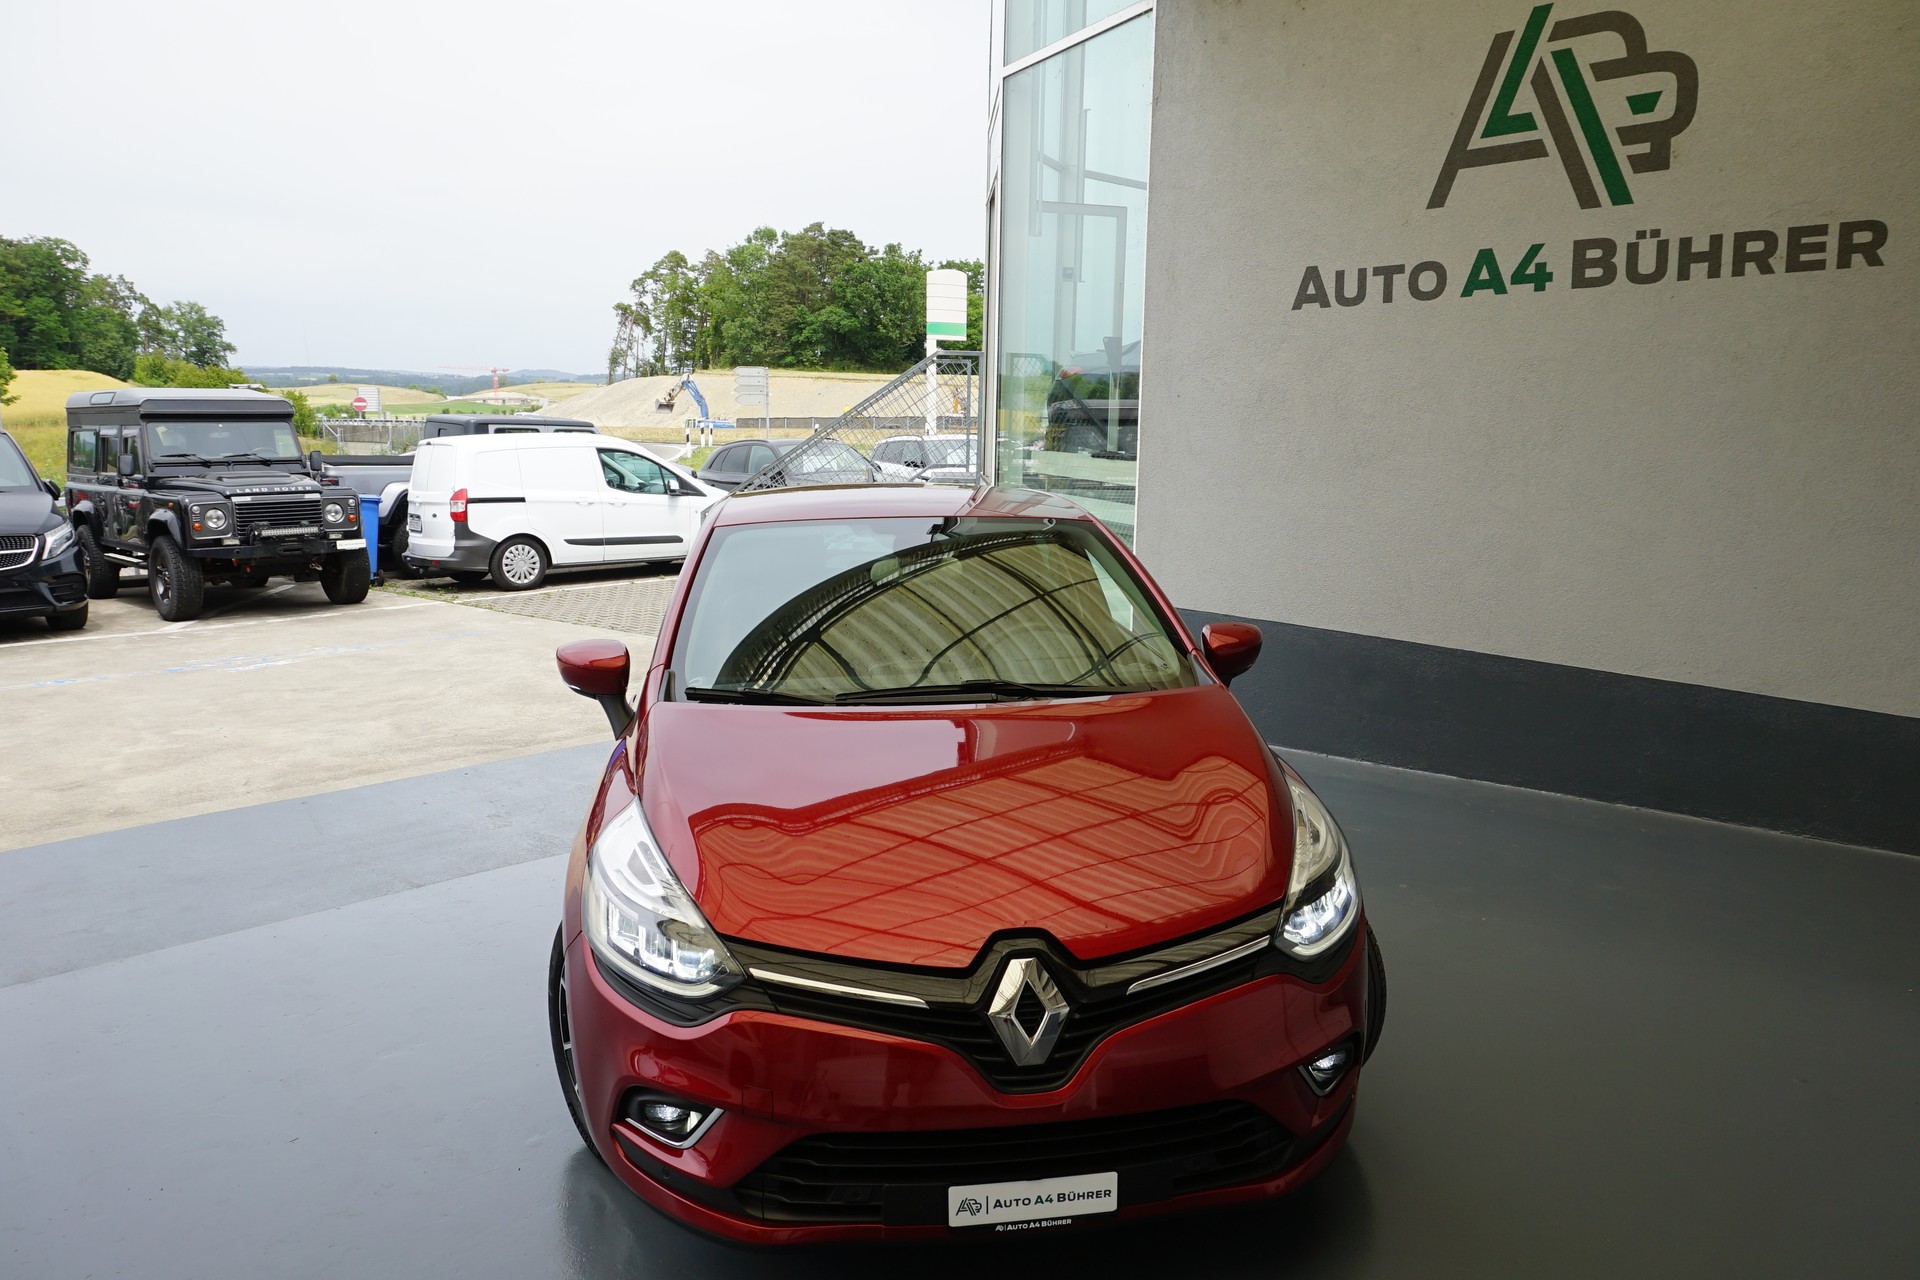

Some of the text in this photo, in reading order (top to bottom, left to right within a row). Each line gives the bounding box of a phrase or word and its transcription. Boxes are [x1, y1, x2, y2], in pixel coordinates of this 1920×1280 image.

[1291, 219, 1889, 311] AUTO A4 BÜHRER
[993, 1197, 1031, 1210] AUTO
[1034, 1194, 1054, 1205] A4
[1057, 1189, 1112, 1203] BÜHRER
[1007, 1223, 1028, 1231] AUTO
[1029, 1221, 1041, 1229] A4
[1041, 1218, 1072, 1227] BÜHRER
